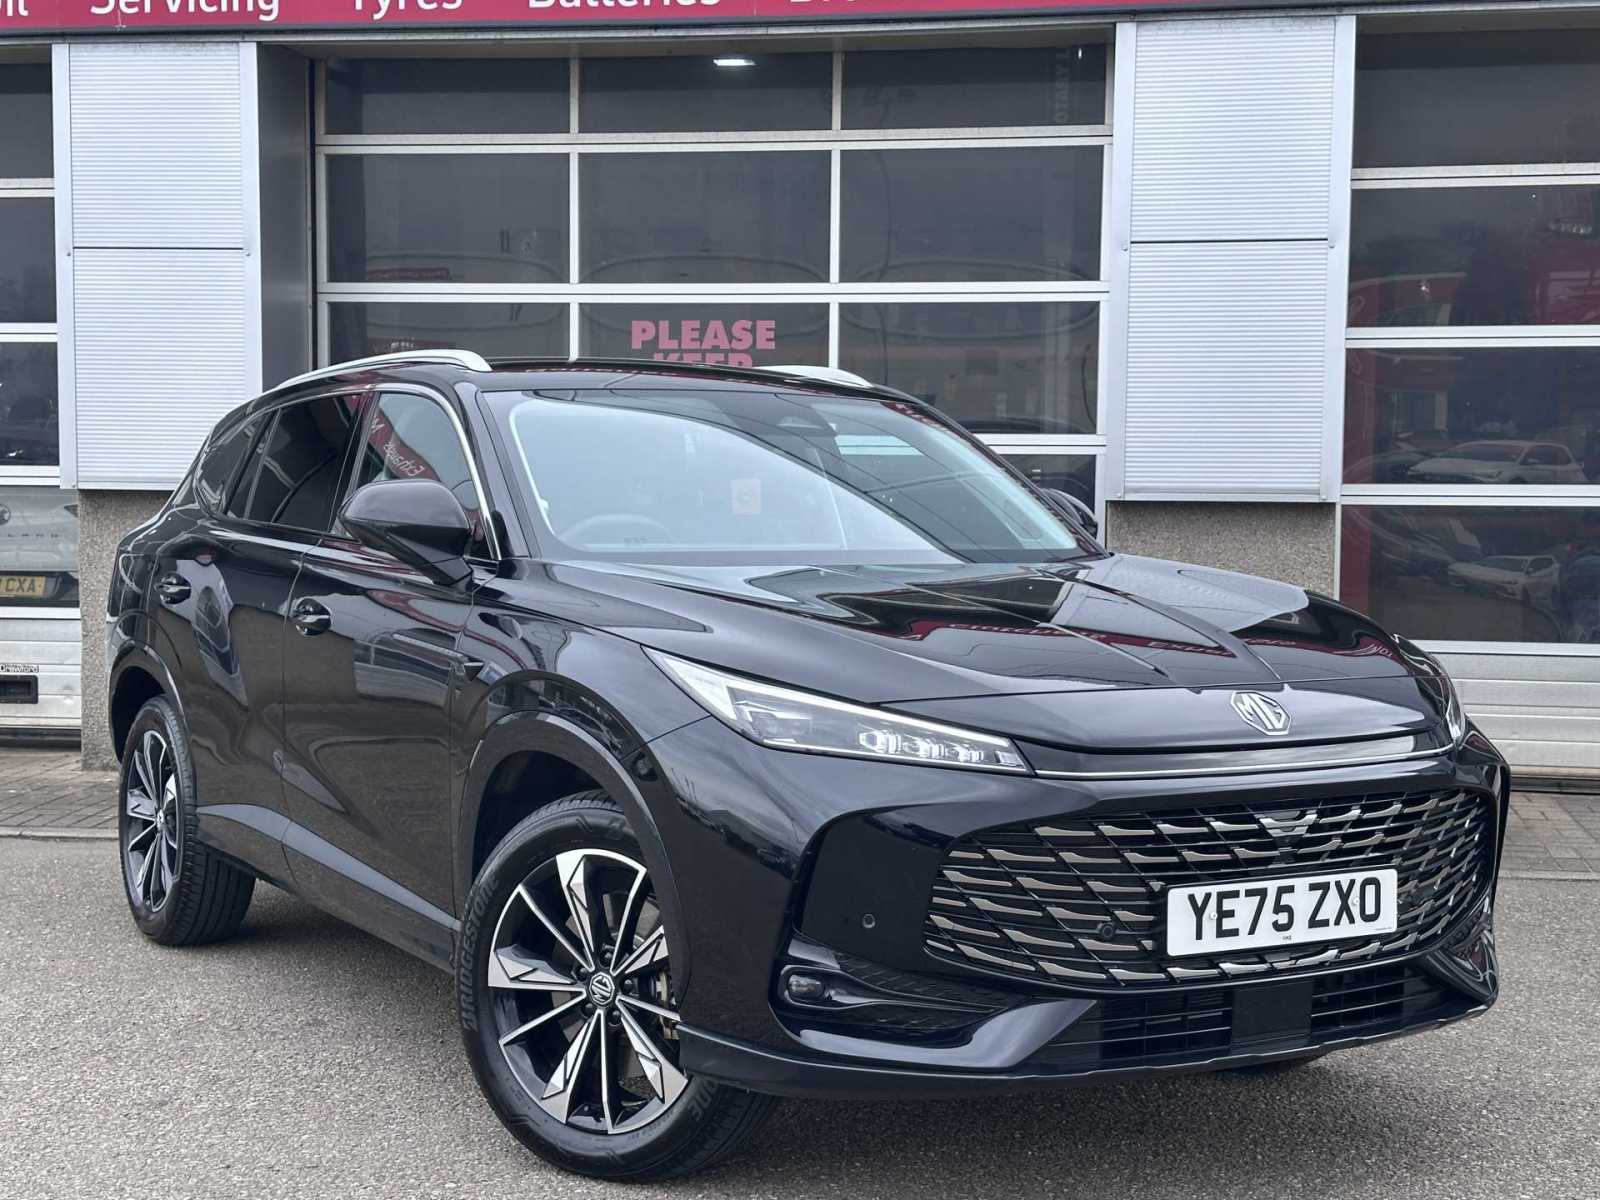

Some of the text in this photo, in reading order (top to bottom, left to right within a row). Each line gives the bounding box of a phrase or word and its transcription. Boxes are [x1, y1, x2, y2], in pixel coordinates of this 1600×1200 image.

[631, 320, 776, 350] PLEASE
[1236, 693, 1287, 731] MG
[1187, 877, 1381, 941] YE75 ZXO
[459, 877, 500, 1033] BRIDGESTONE
